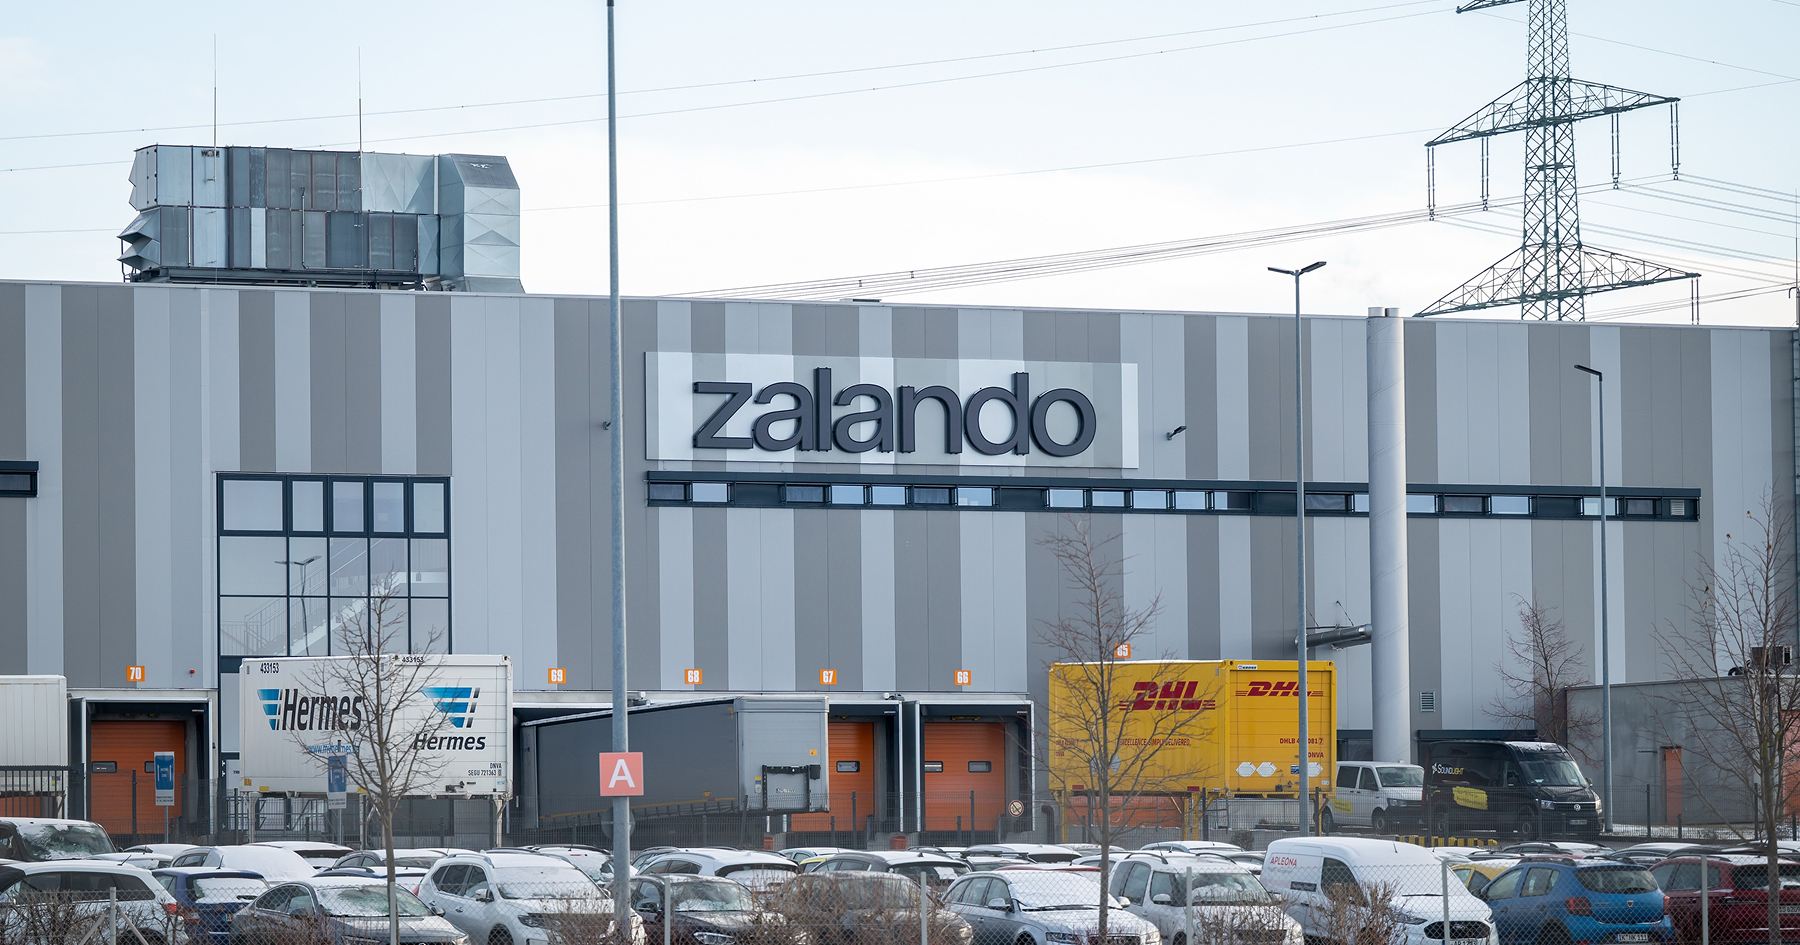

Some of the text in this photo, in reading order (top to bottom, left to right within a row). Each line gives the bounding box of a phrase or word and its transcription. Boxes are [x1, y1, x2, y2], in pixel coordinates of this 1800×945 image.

[692, 366, 1097, 457] zalando
[130, 667, 142, 680] 70
[260, 662, 280, 674] 433153
[551, 669, 563, 682] 69
[687, 670, 700, 682] 68
[822, 670, 834, 683] 67
[957, 671, 969, 683] 66
[1131, 681, 1203, 710] DHL
[282, 689, 363, 731] Hermes
[412, 733, 486, 750] Hermes
[608, 758, 636, 788] A
[1270, 856, 1297, 867] APLEONA
